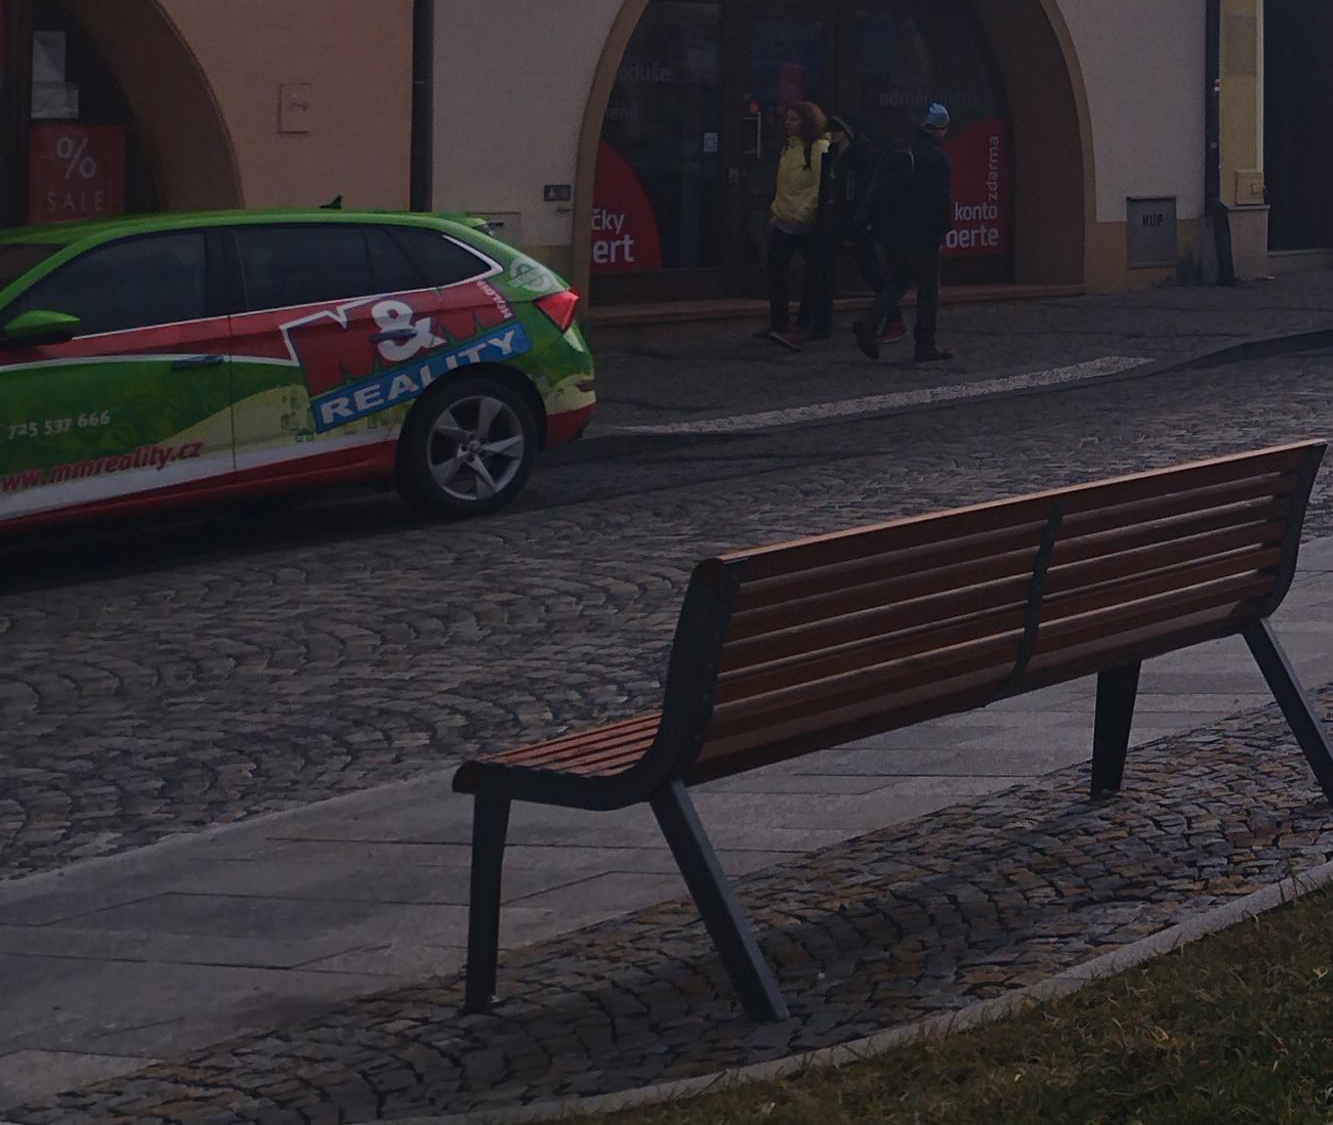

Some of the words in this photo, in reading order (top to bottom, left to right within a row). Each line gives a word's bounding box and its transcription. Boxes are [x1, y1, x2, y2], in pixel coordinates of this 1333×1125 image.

[984, 135, 1001, 202] zdarma
[46, 190, 105, 213] SALE
[954, 201, 998, 222] konto
[592, 233, 636, 264] ert
[319, 330, 516, 425] REALITY
[77, 409, 111, 429] 666
